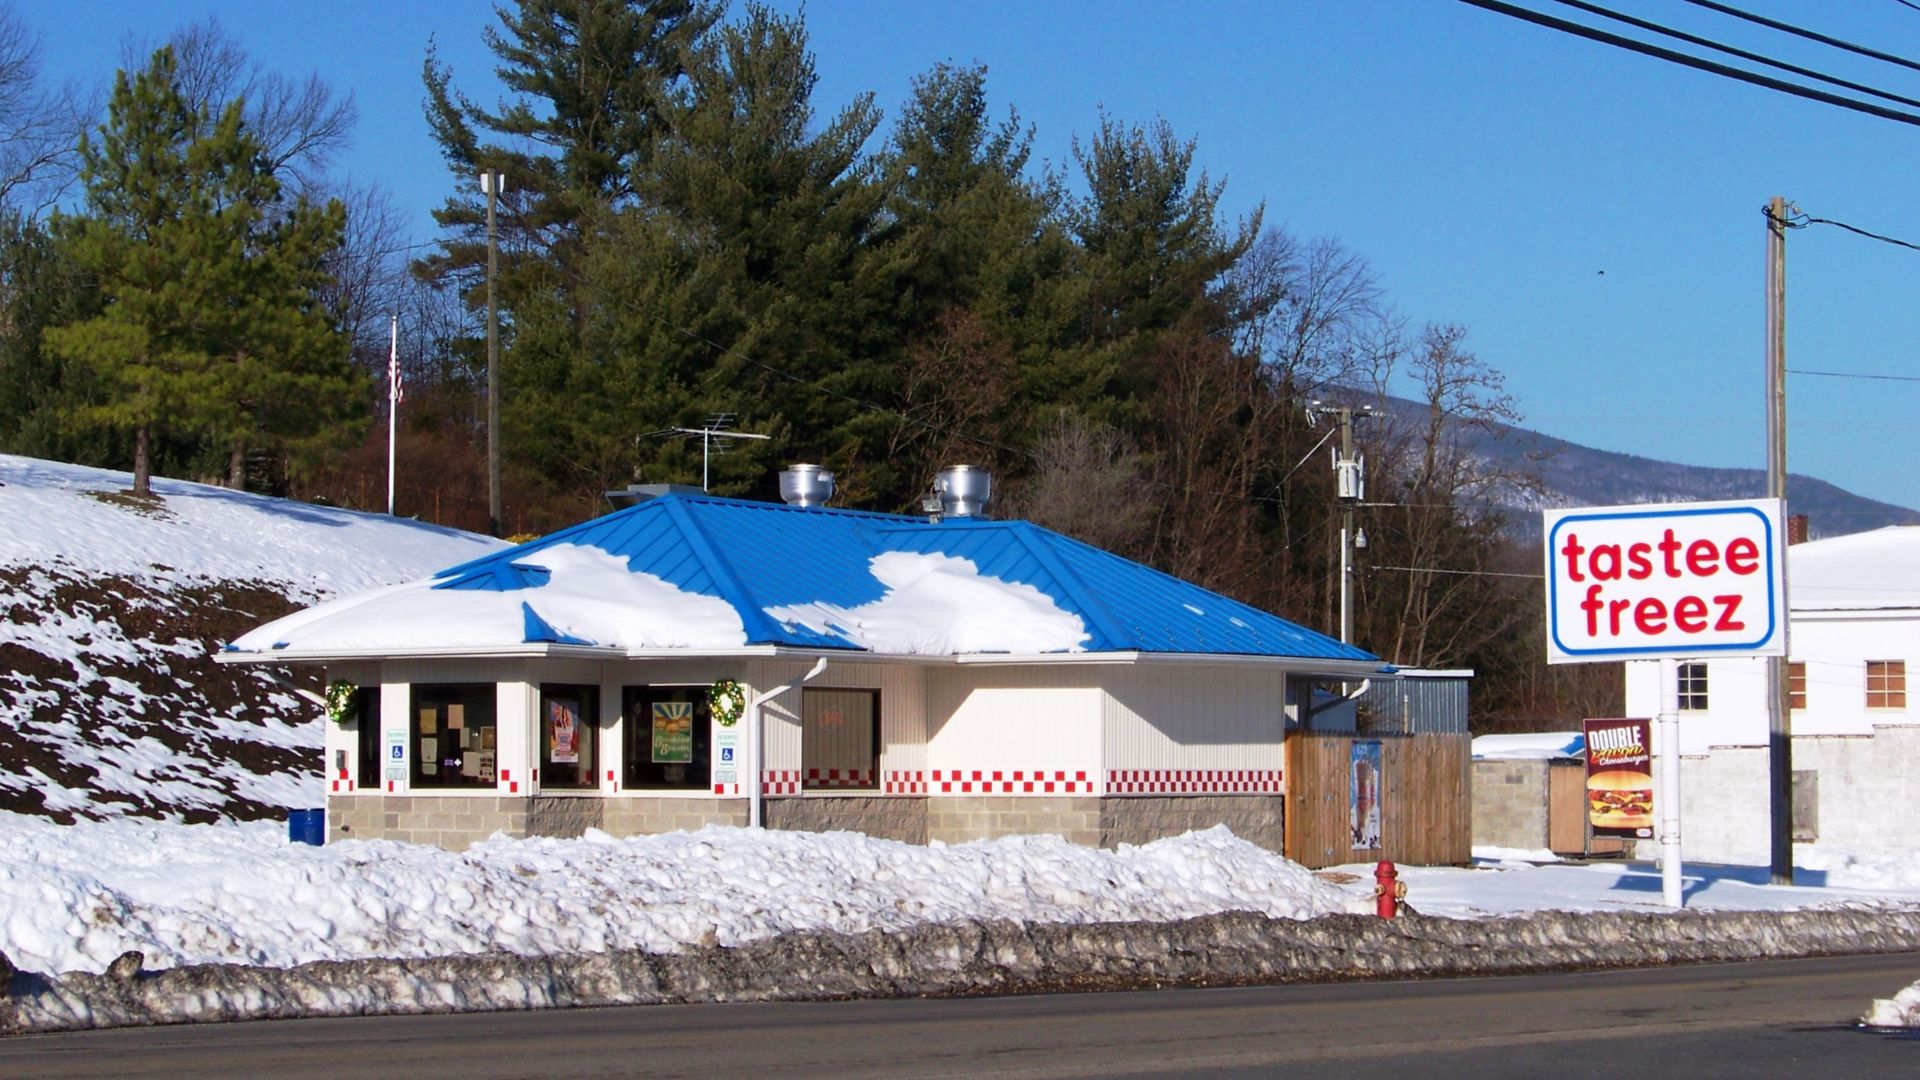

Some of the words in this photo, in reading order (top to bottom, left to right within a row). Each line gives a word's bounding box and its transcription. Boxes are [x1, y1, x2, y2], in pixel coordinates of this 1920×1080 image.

[1562, 528, 1760, 582] tastee
[1580, 584, 1745, 637] freez
[1588, 726, 1642, 750] DOUBLE
